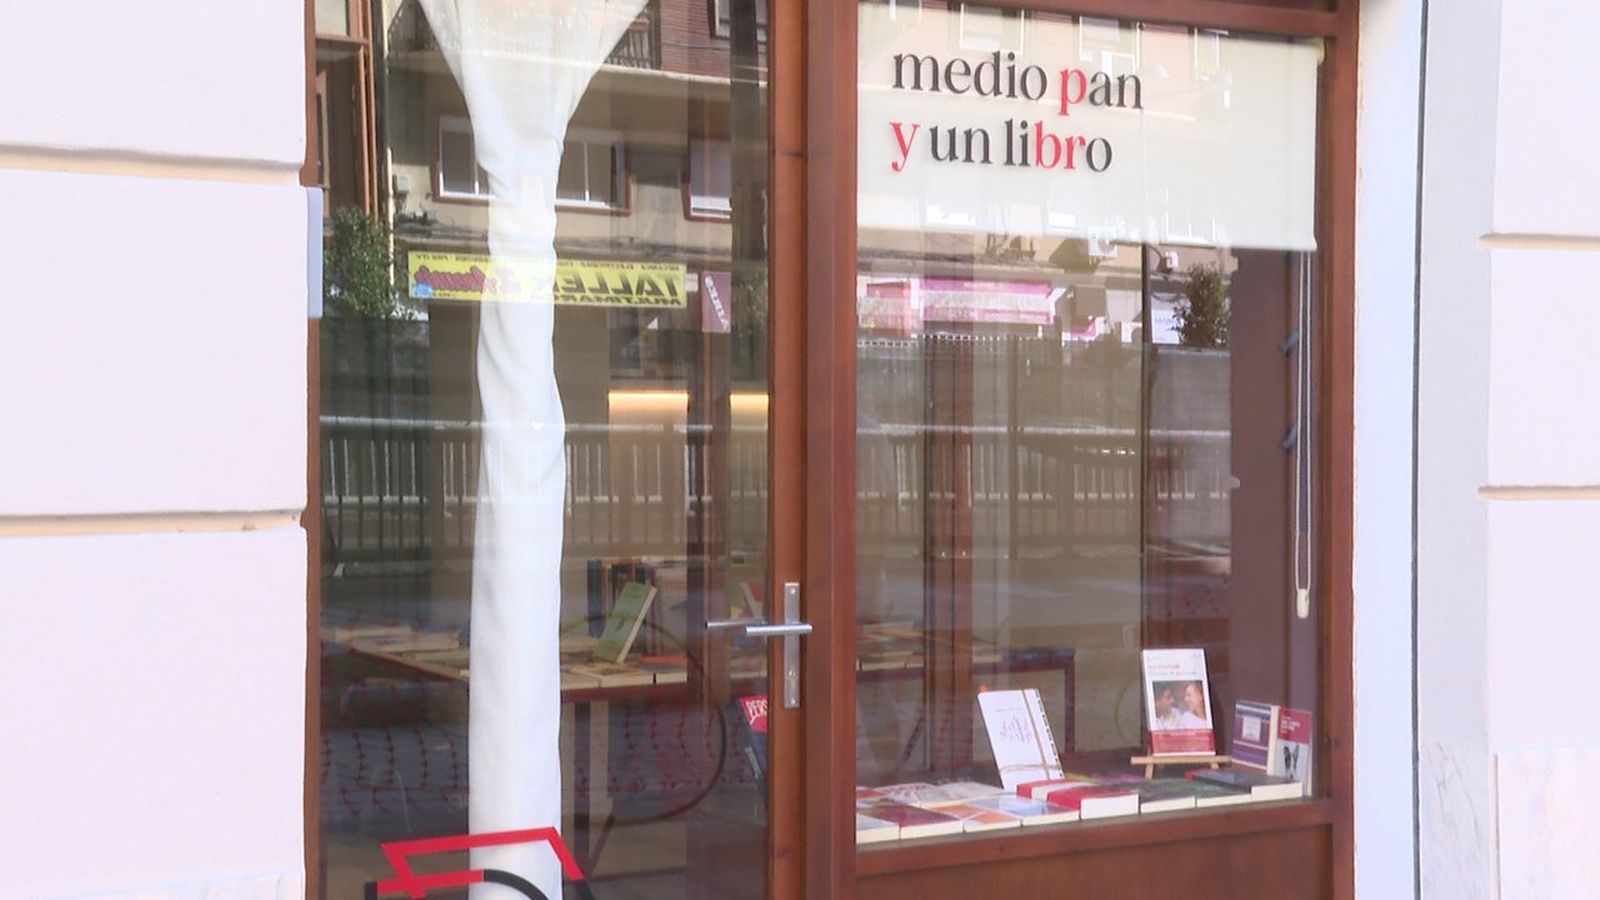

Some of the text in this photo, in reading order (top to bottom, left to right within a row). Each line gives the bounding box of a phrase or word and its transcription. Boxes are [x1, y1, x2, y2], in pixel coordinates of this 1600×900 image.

[892, 50, 1144, 116] medio pan
[889, 118, 1113, 172] y un libro
